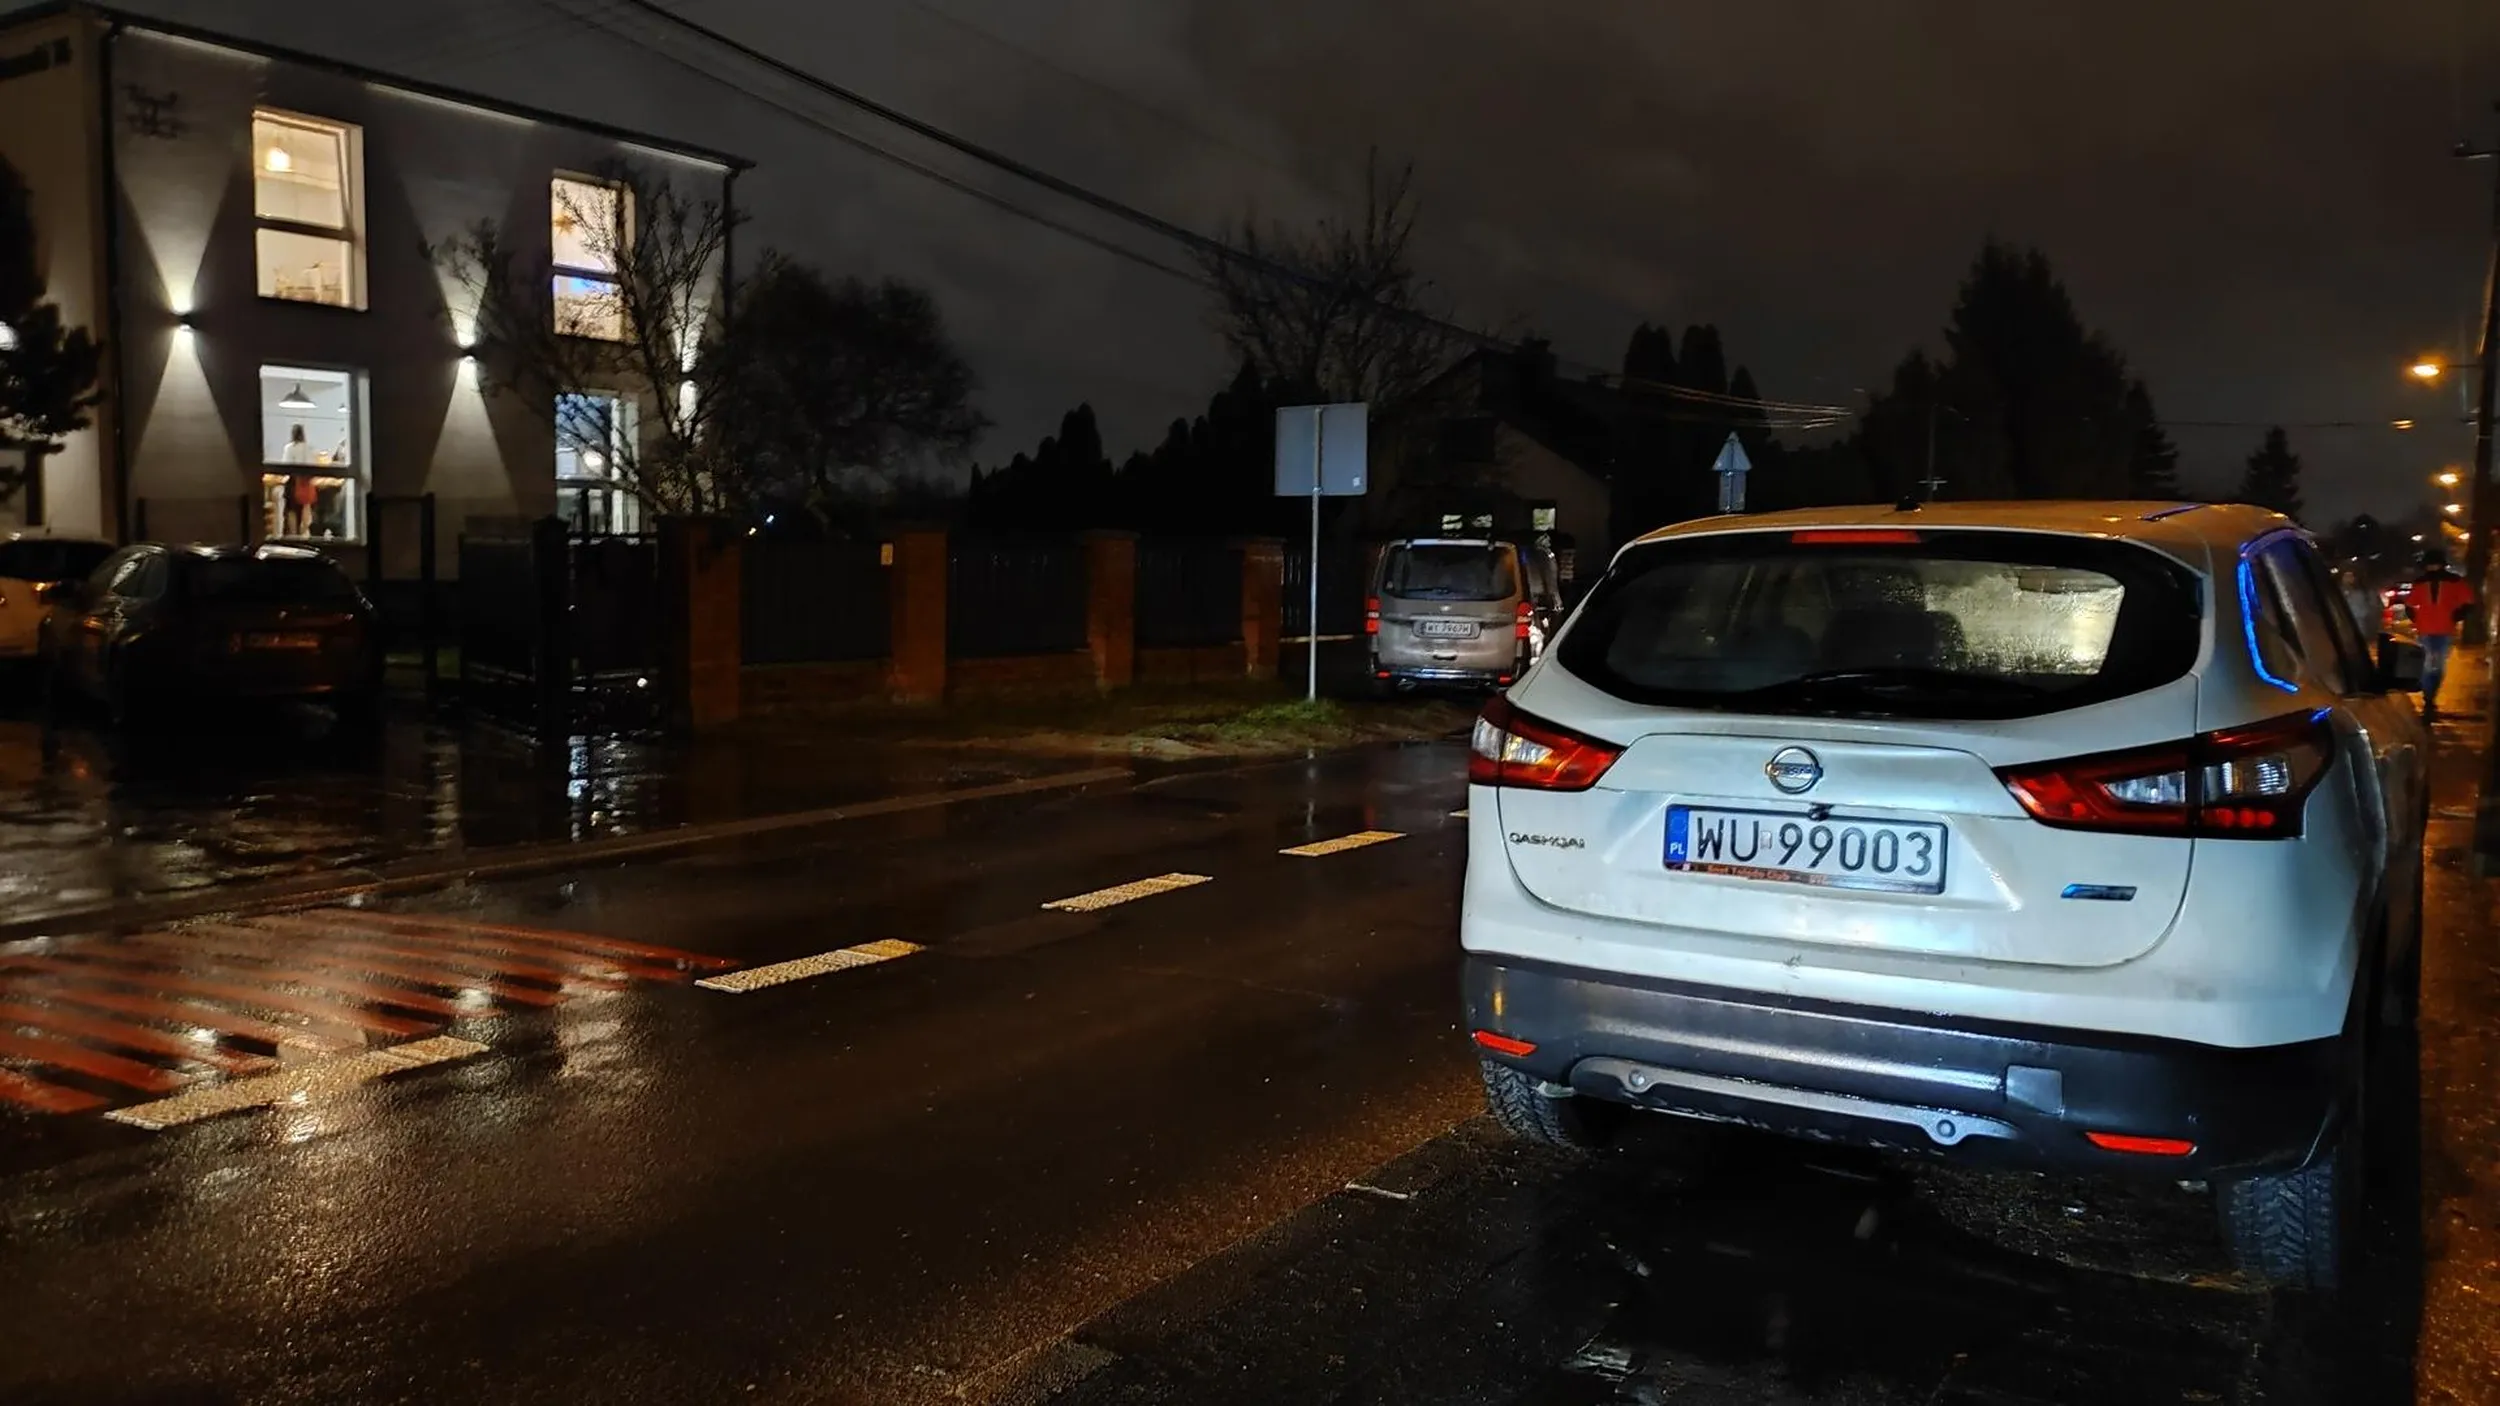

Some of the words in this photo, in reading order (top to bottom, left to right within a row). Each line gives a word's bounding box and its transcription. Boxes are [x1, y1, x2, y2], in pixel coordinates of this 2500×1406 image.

[1508, 832, 1585, 849] QASHQAI
[1669, 842, 1685, 855] PL
[1697, 817, 1759, 862] WU
[1777, 822, 1934, 877] 99003
